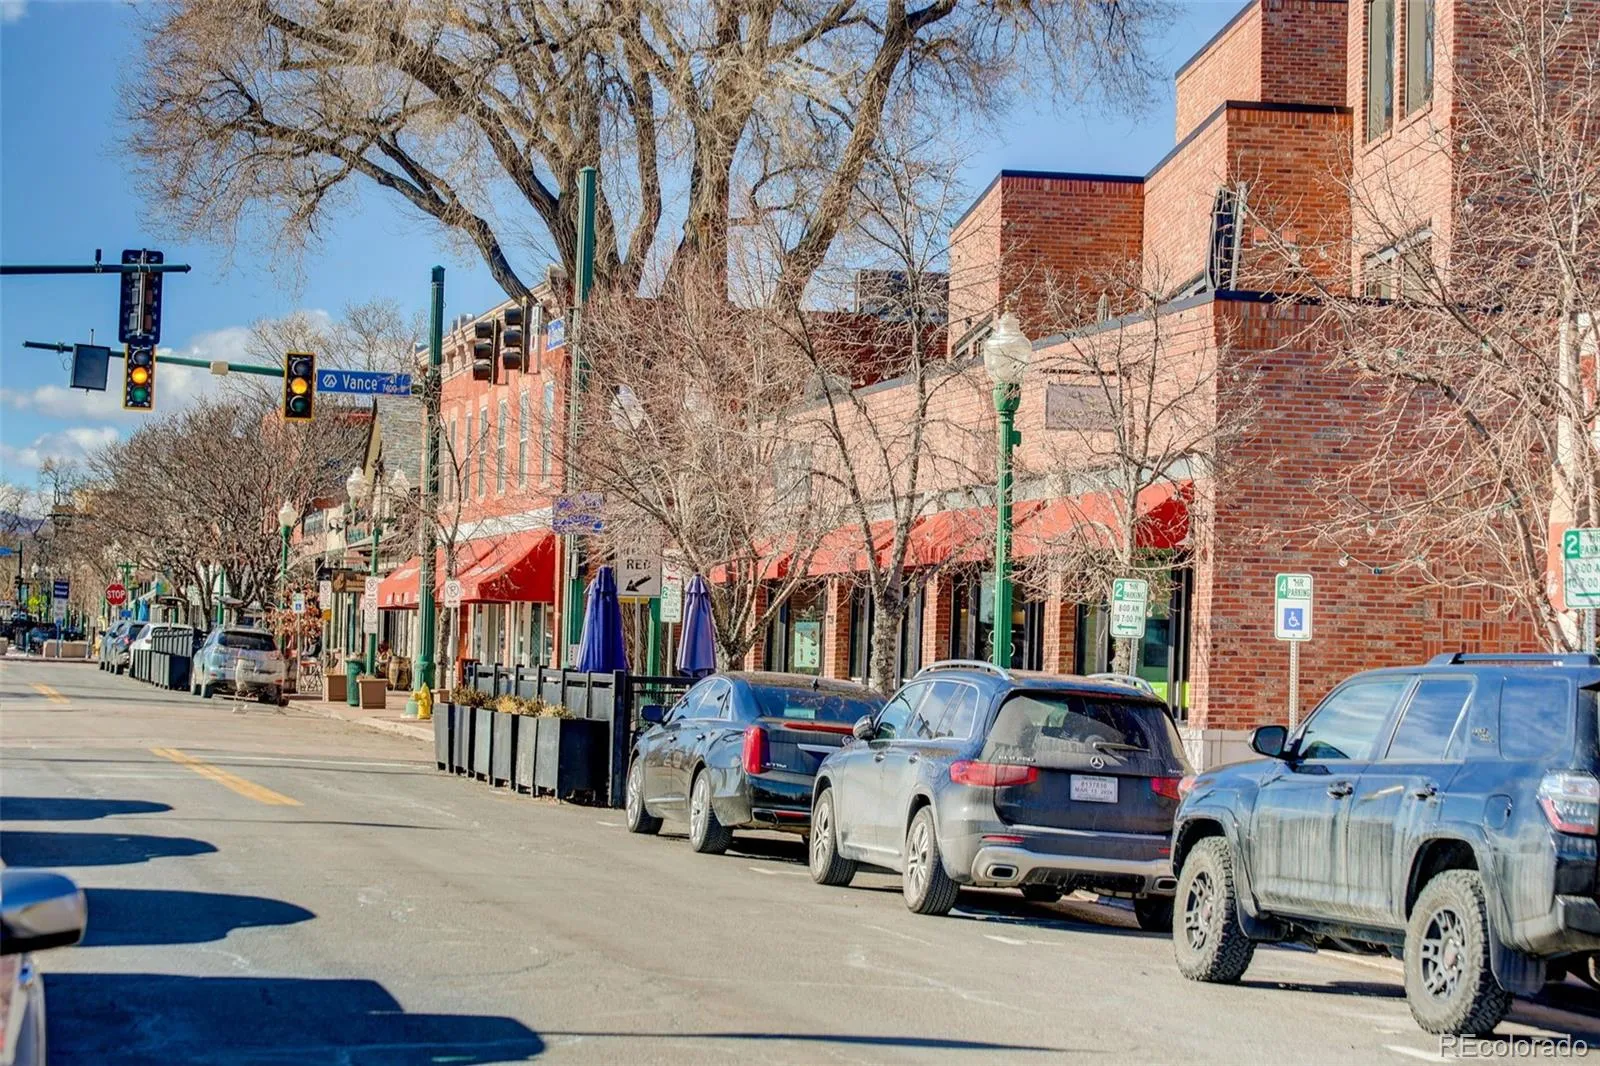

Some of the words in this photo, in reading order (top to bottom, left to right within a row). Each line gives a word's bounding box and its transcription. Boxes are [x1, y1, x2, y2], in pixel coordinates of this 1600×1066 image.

[342, 374, 378, 390] Vance
[1566, 534, 1578, 554] 2
[106, 590, 125, 599] STOP
[1115, 583, 1122, 598] 2
[1279, 579, 1287, 595] 4
[1287, 588, 1311, 596] PARKING
